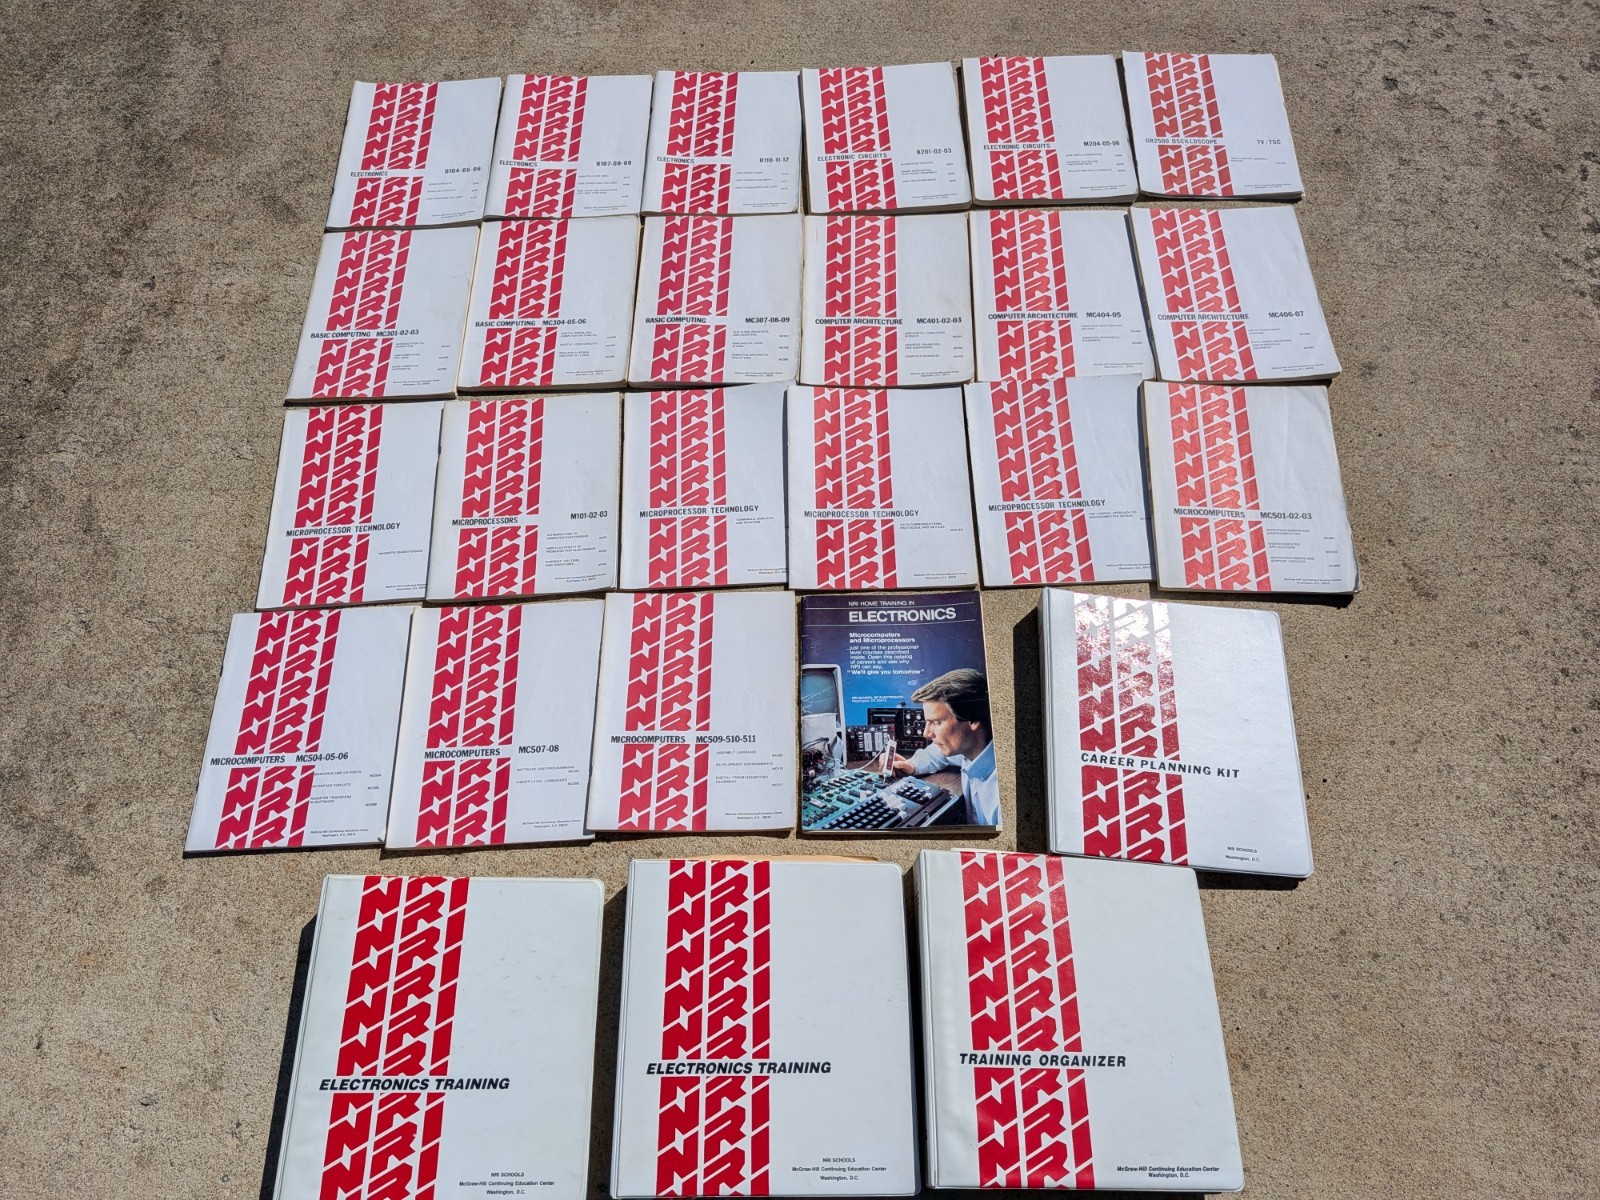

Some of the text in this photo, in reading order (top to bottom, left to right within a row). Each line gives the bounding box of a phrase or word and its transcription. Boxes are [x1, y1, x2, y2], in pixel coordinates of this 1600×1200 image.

[1171, 137, 1218, 145] OSCILLOSCOPE
[656, 156, 695, 164] ELECTRONICS
[817, 152, 888, 161] ELECTRONIC CIRCUITS
[499, 159, 538, 168] ELECTRONICS
[350, 170, 389, 178] ELECTRONICS
[988, 312, 1026, 320] COMPUTER
[1086, 311, 1122, 319] MC404-05
[1157, 313, 1250, 321] COMPUTER ARCHITECTURE
[1268, 310, 1304, 319] MC406-07
[541, 318, 587, 326] MC304-05-06
[744, 316, 791, 324] MC307-08-09
[916, 316, 962, 324] MC401-02-03
[310, 331, 331, 339] BASIC
[375, 329, 420, 337] MC301-02-03
[987, 499, 1106, 512] MICROPROCESSOR TECHNOLOGY
[570, 510, 608, 520] M101-02-03
[639, 504, 760, 518] MICROPROCESSOR TECHNOLOGY
[803, 509, 919, 518] MICROPROCESSOR TECHNOLOGY
[1173, 507, 1246, 519] MICROCOMPUTERS
[1260, 511, 1313, 520] MC501-02-03
[451, 516, 519, 527] MICROPROCESSORS
[285, 521, 401, 538] MICROPROCESSOR TECHNOLOGY
[848, 607, 957, 623] ELECTRONICS
[849, 632, 901, 640] Microcomputers
[863, 637, 916, 645] Microprocessors
[610, 735, 686, 744] MICROCOMPUTERS
[695, 734, 756, 744] MC509-510-511
[424, 747, 501, 759] MICROCOMPUTERS
[518, 744, 560, 754] MC507-08
[209, 755, 286, 766] MICROCOMPUTERS
[295, 752, 349, 763] MC504-05-06
[1080, 752, 1241, 779] CAREER PLANNING KIT
[1235, 846, 1258, 854] SCHOOLS
[959, 1053, 1127, 1068] TRAINING ORGANIZER
[646, 1061, 832, 1075] ELECTRONICS TRAINING
[318, 1077, 511, 1092] ELECTRONICS TRAINING
[820, 1165, 846, 1173] Continuing
[1148, 1165, 1176, 1173] Continuing
[819, 1174, 849, 1182] Washington,
[488, 1180, 514, 1188] Continuing
[514, 1179, 539, 1187] Education
[539, 1179, 555, 1187] Center
[485, 1188, 516, 1196] Washington,
